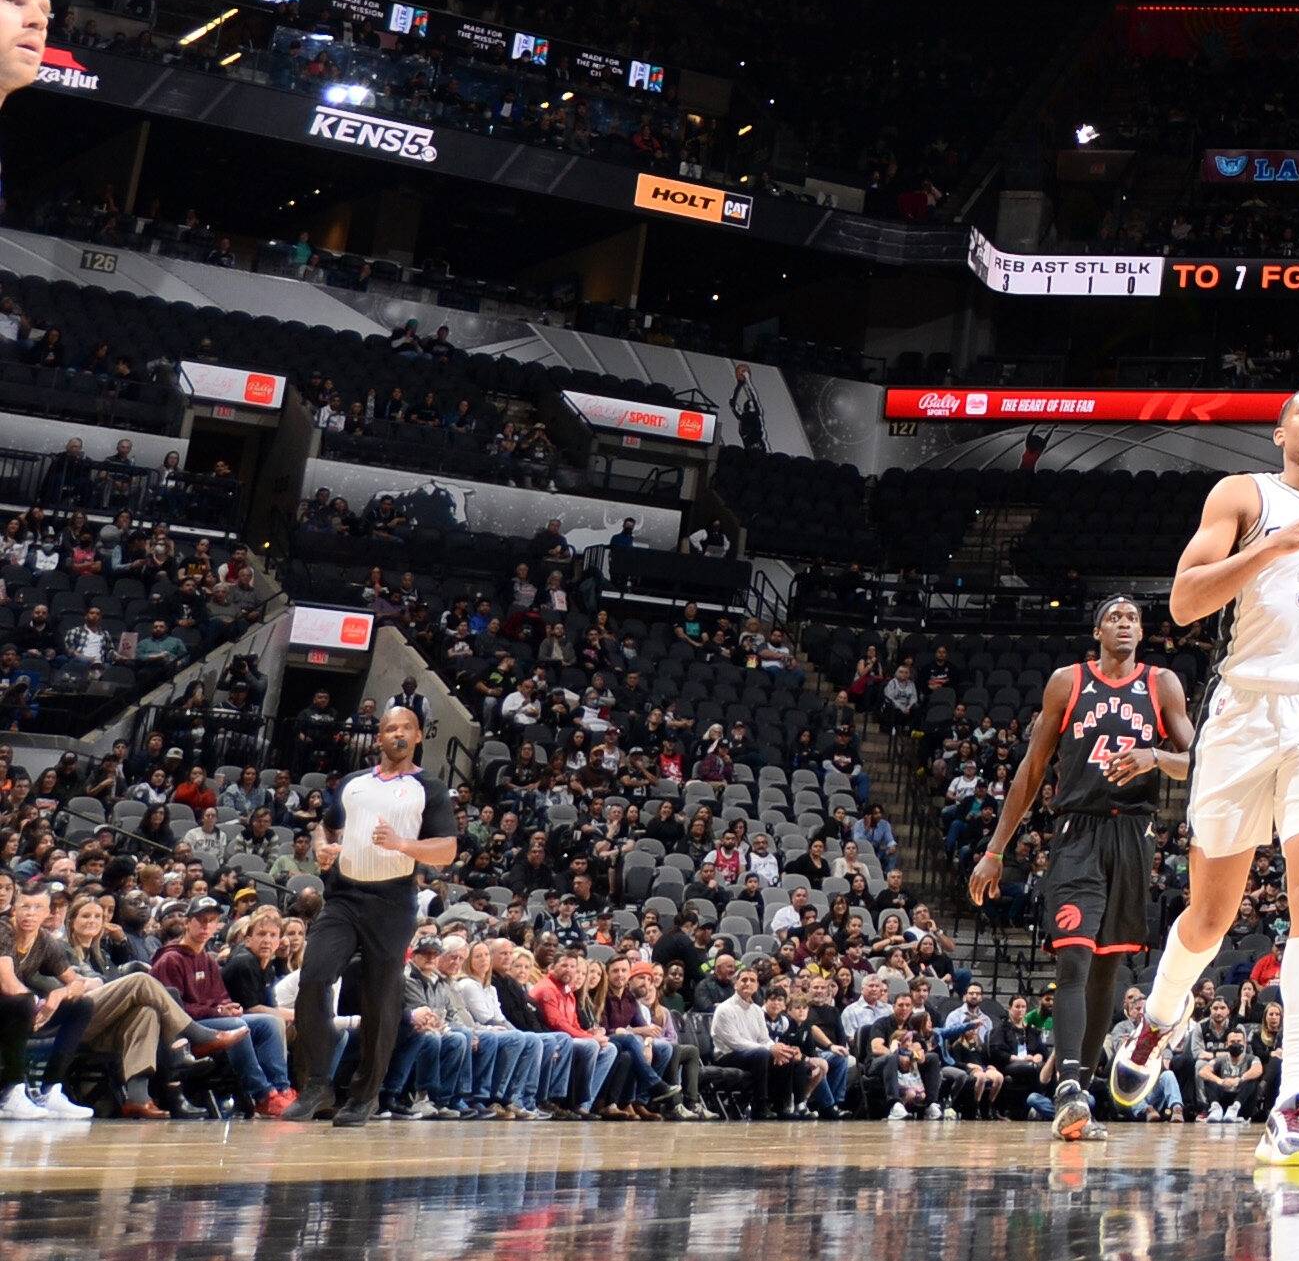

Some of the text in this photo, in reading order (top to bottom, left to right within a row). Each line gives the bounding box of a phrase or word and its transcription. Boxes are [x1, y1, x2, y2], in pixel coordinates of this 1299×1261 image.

[1253, 158, 1299, 180] LA
[652, 187, 748, 219] HOLT CAT
[84, 253, 115, 271] 126
[1031, 261, 1068, 274] AST
[1074, 261, 1109, 274] STL
[1115, 262, 1150, 275] BLK
[1173, 265, 1218, 289] TO
[1235, 266, 1246, 290] 7
[919, 393, 960, 413] Bally
[1001, 399, 1018, 411] THE
[1020, 399, 1046, 412] HEART
[1059, 400, 1076, 412] THE
[1077, 400, 1095, 412] FAN
[1074, 697, 1153, 741] RAPTORS
